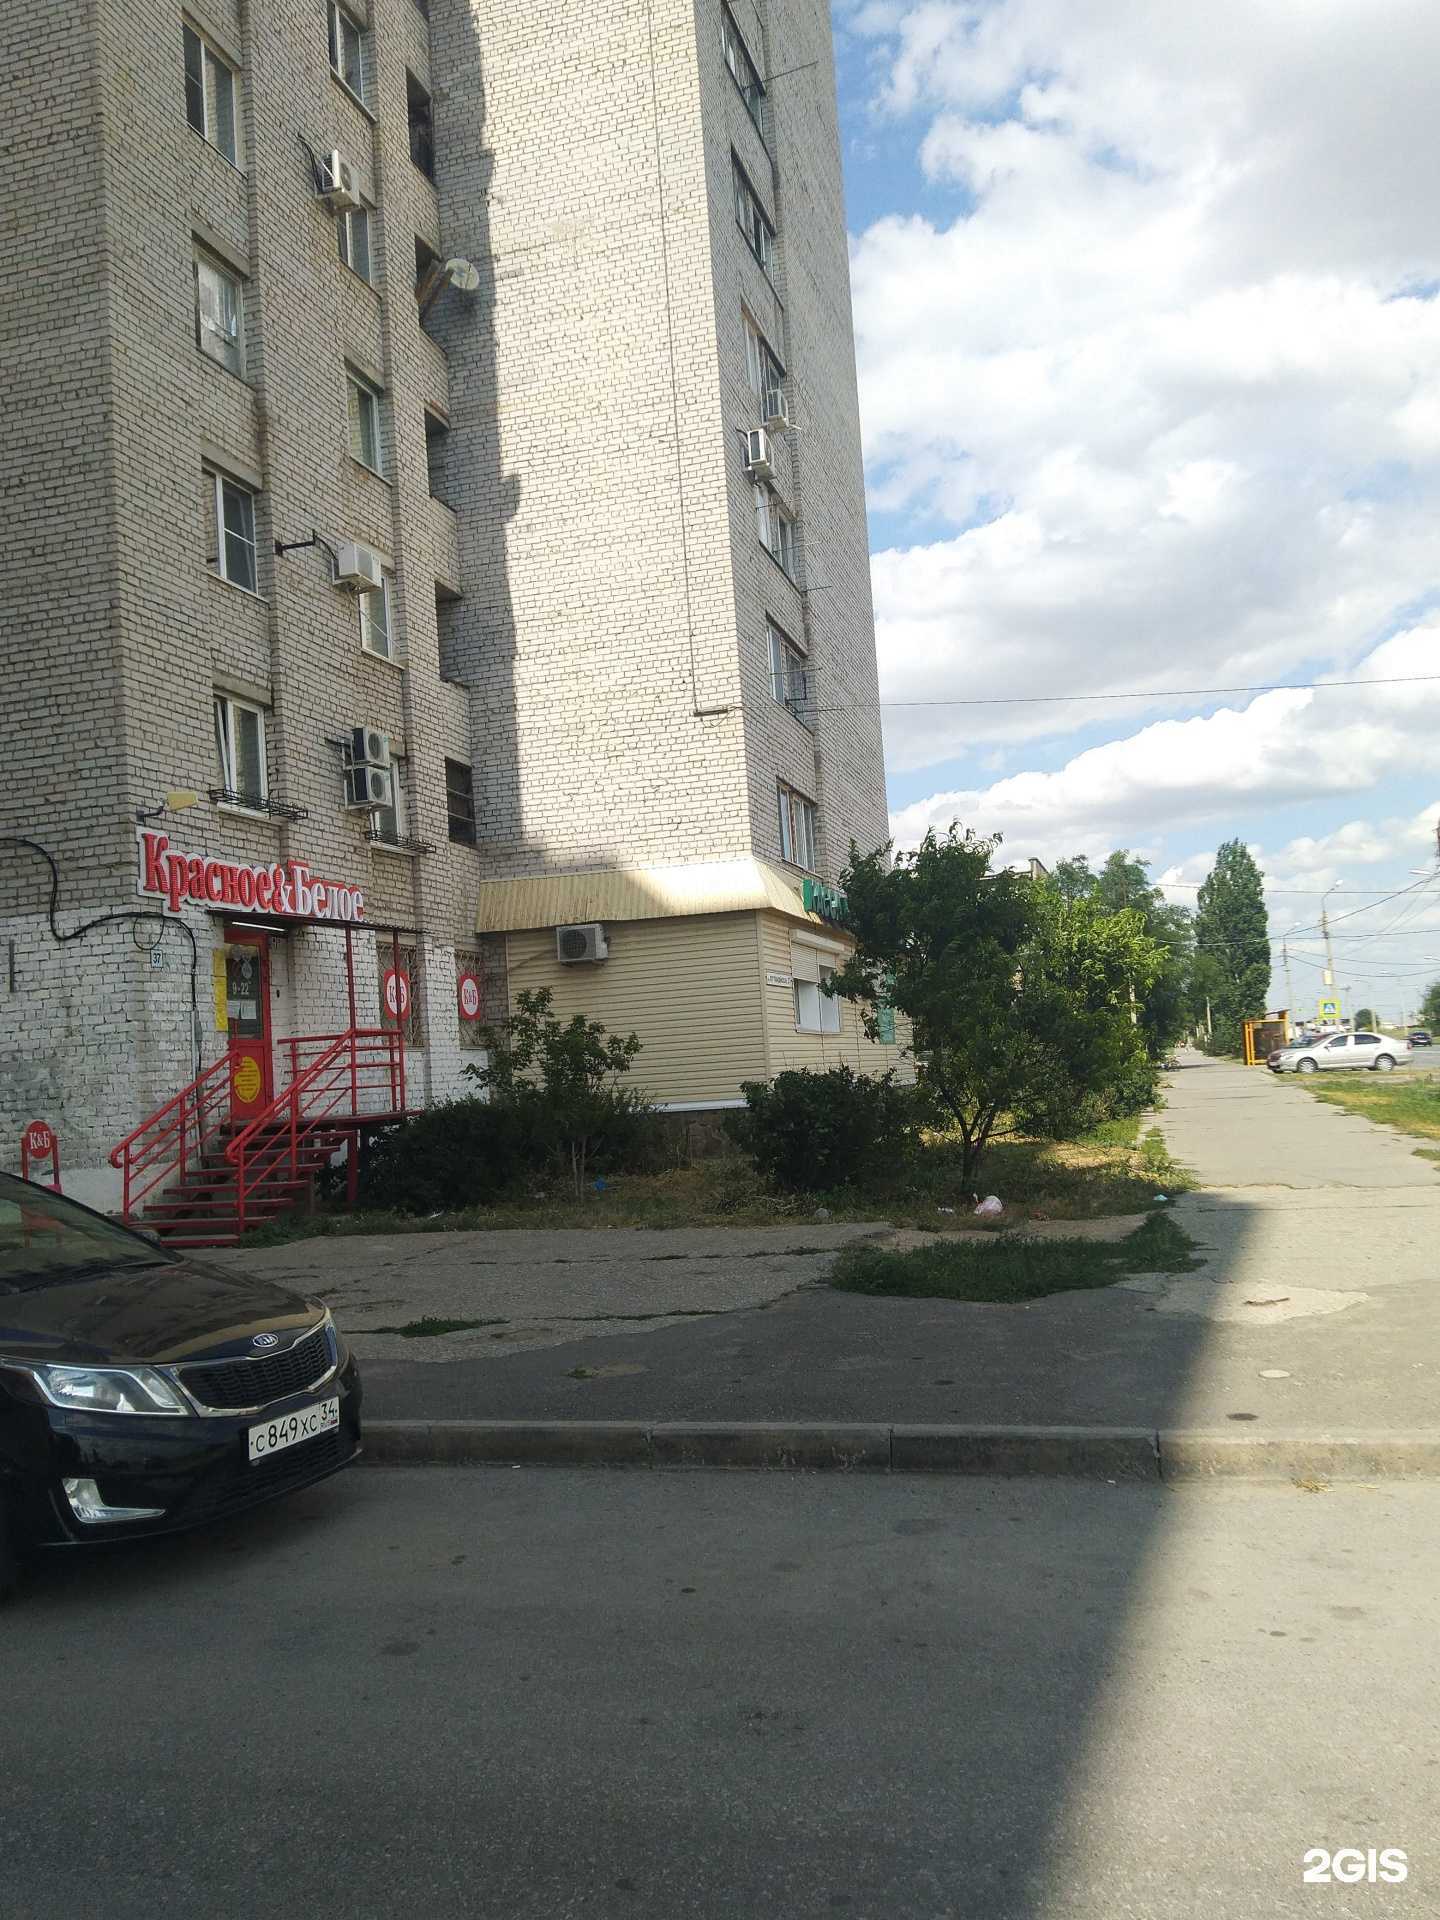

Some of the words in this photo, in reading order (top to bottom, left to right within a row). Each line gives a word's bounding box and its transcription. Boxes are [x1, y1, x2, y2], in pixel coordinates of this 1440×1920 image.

[153, 953, 161, 964] 37
[389, 986, 405, 1003] КБ
[29, 1131, 50, 1149] К&Б
[321, 1401, 335, 1420] 34
